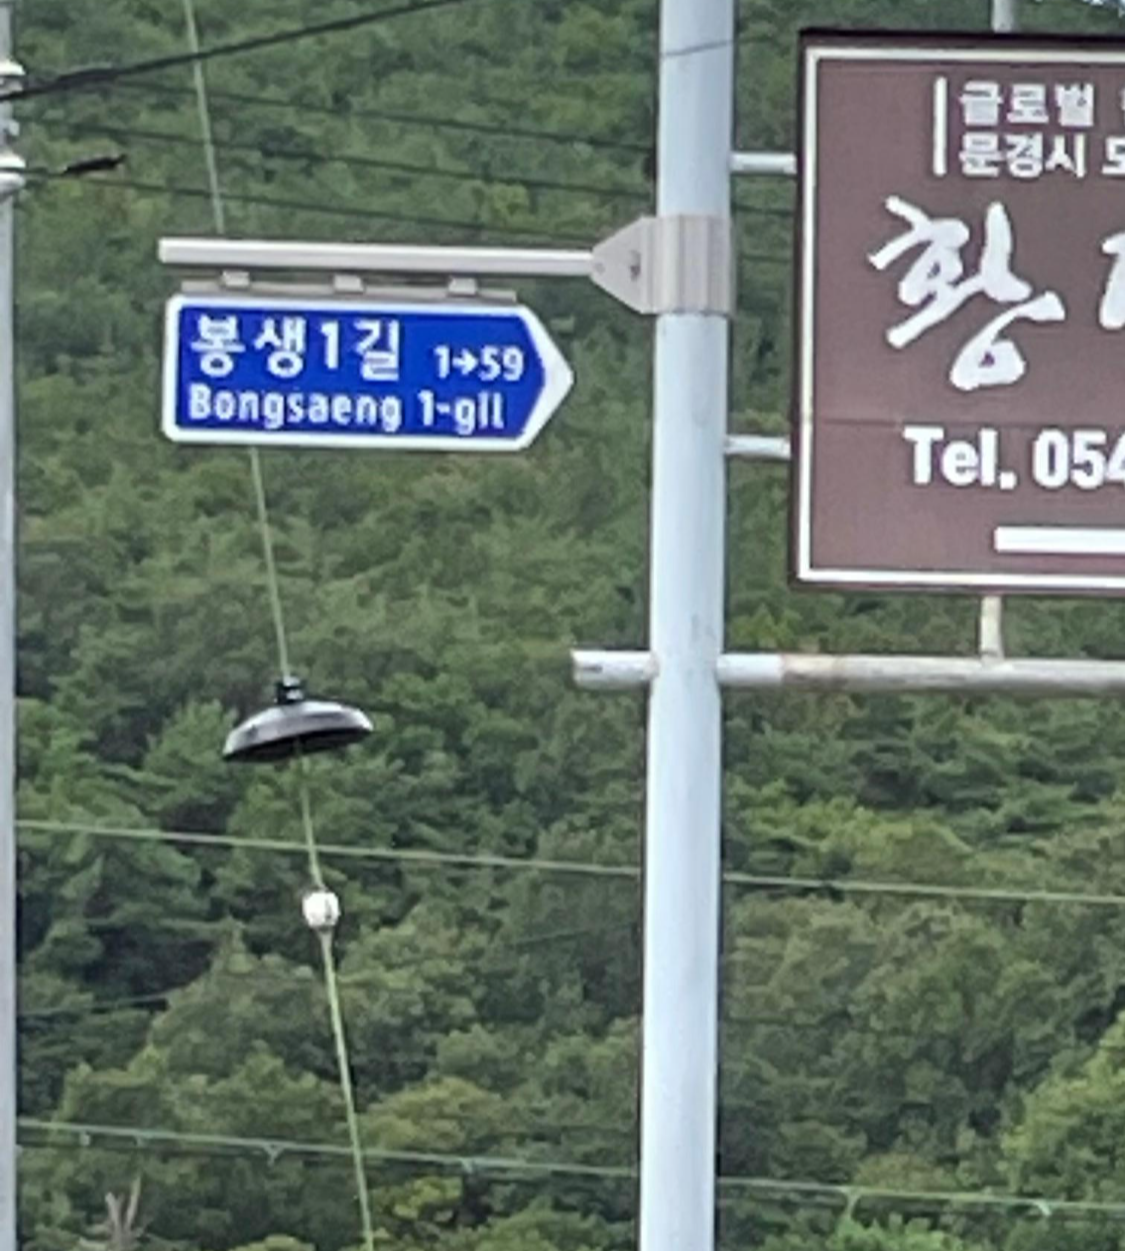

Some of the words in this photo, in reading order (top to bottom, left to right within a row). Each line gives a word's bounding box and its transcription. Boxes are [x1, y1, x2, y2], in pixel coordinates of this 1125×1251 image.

[960, 81, 1094, 127] 글로벌
[959, 132, 1086, 178] 문경시
[190, 313, 400, 381] 봉생1길
[187, 383, 401, 433] Bongsaeng
[417, 389, 504, 436] 1-gil
[902, 425, 1017, 490] Tel.
